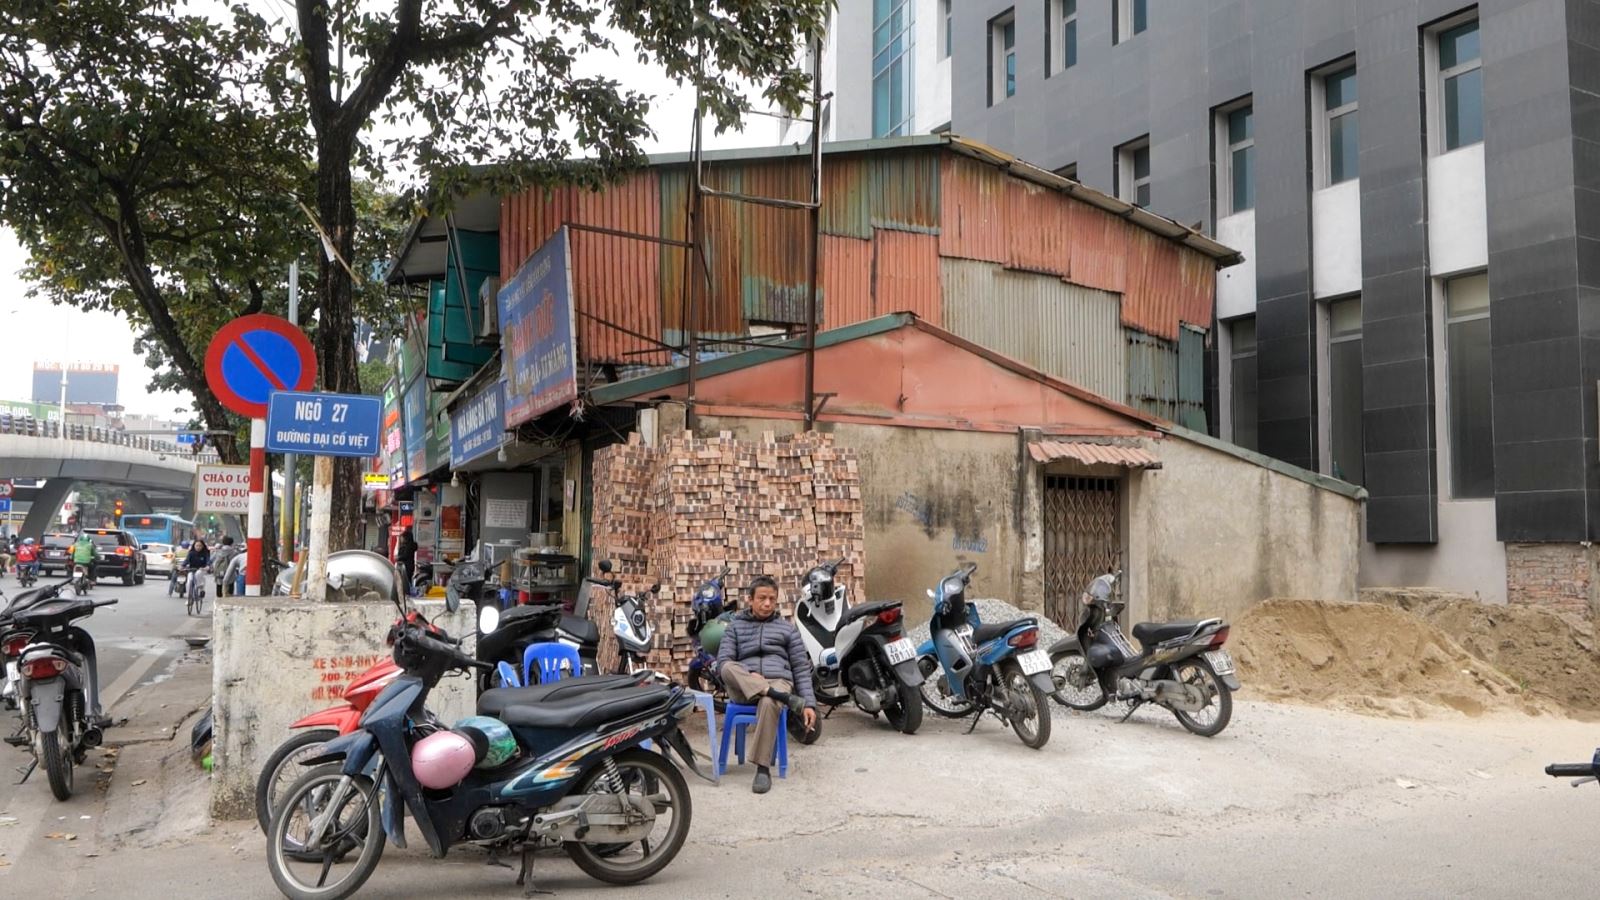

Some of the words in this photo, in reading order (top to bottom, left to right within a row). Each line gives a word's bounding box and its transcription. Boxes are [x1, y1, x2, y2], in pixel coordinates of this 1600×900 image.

[294, 398, 322, 421] NGÕ
[331, 403, 348, 423] 27
[276, 429, 311, 444] ĐƯỜNG
[313, 432, 330, 448] ĐẠI
[348, 433, 370, 449] VIỆT
